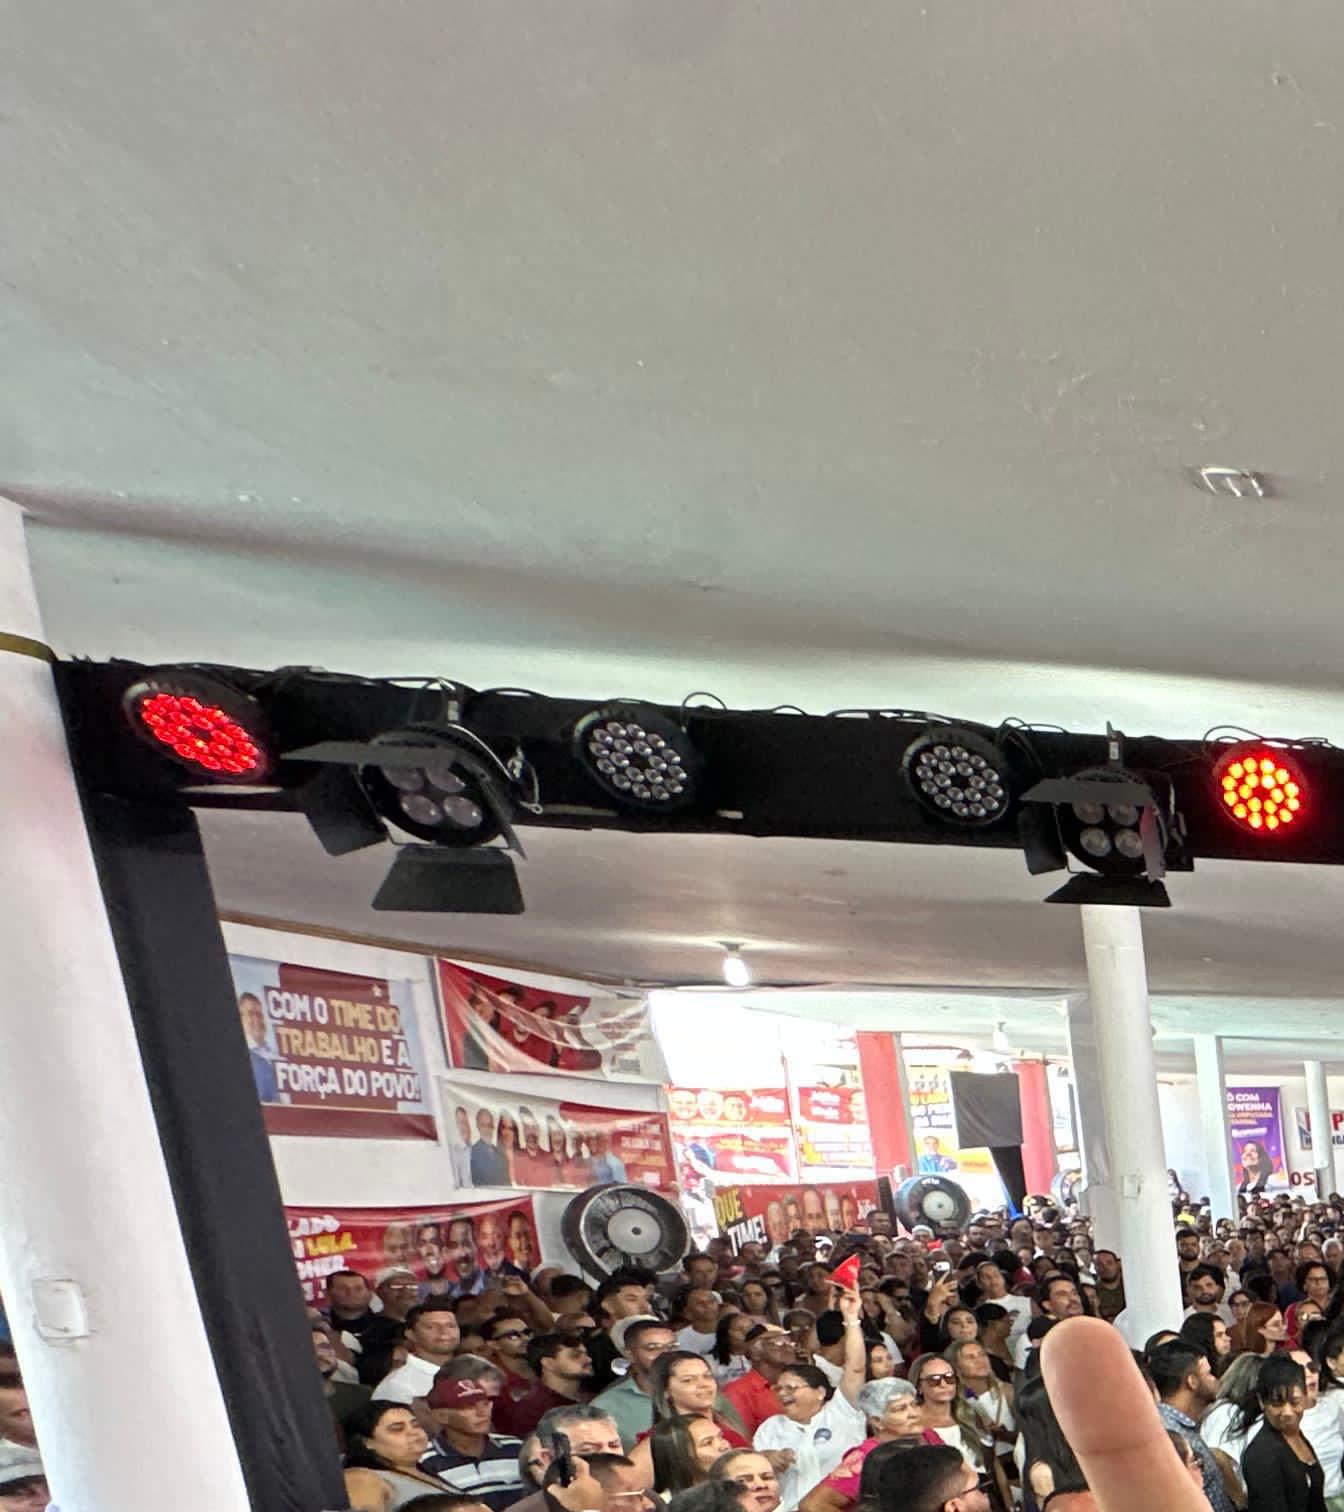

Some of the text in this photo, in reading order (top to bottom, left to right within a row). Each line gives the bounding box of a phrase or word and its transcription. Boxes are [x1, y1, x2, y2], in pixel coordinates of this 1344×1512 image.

[267, 989, 401, 1033] COM O TIME DO
[276, 1026, 412, 1067] TRABALHO E A
[275, 1061, 422, 1099] FORÇA DO POVO!
[716, 1188, 743, 1231] QUE
